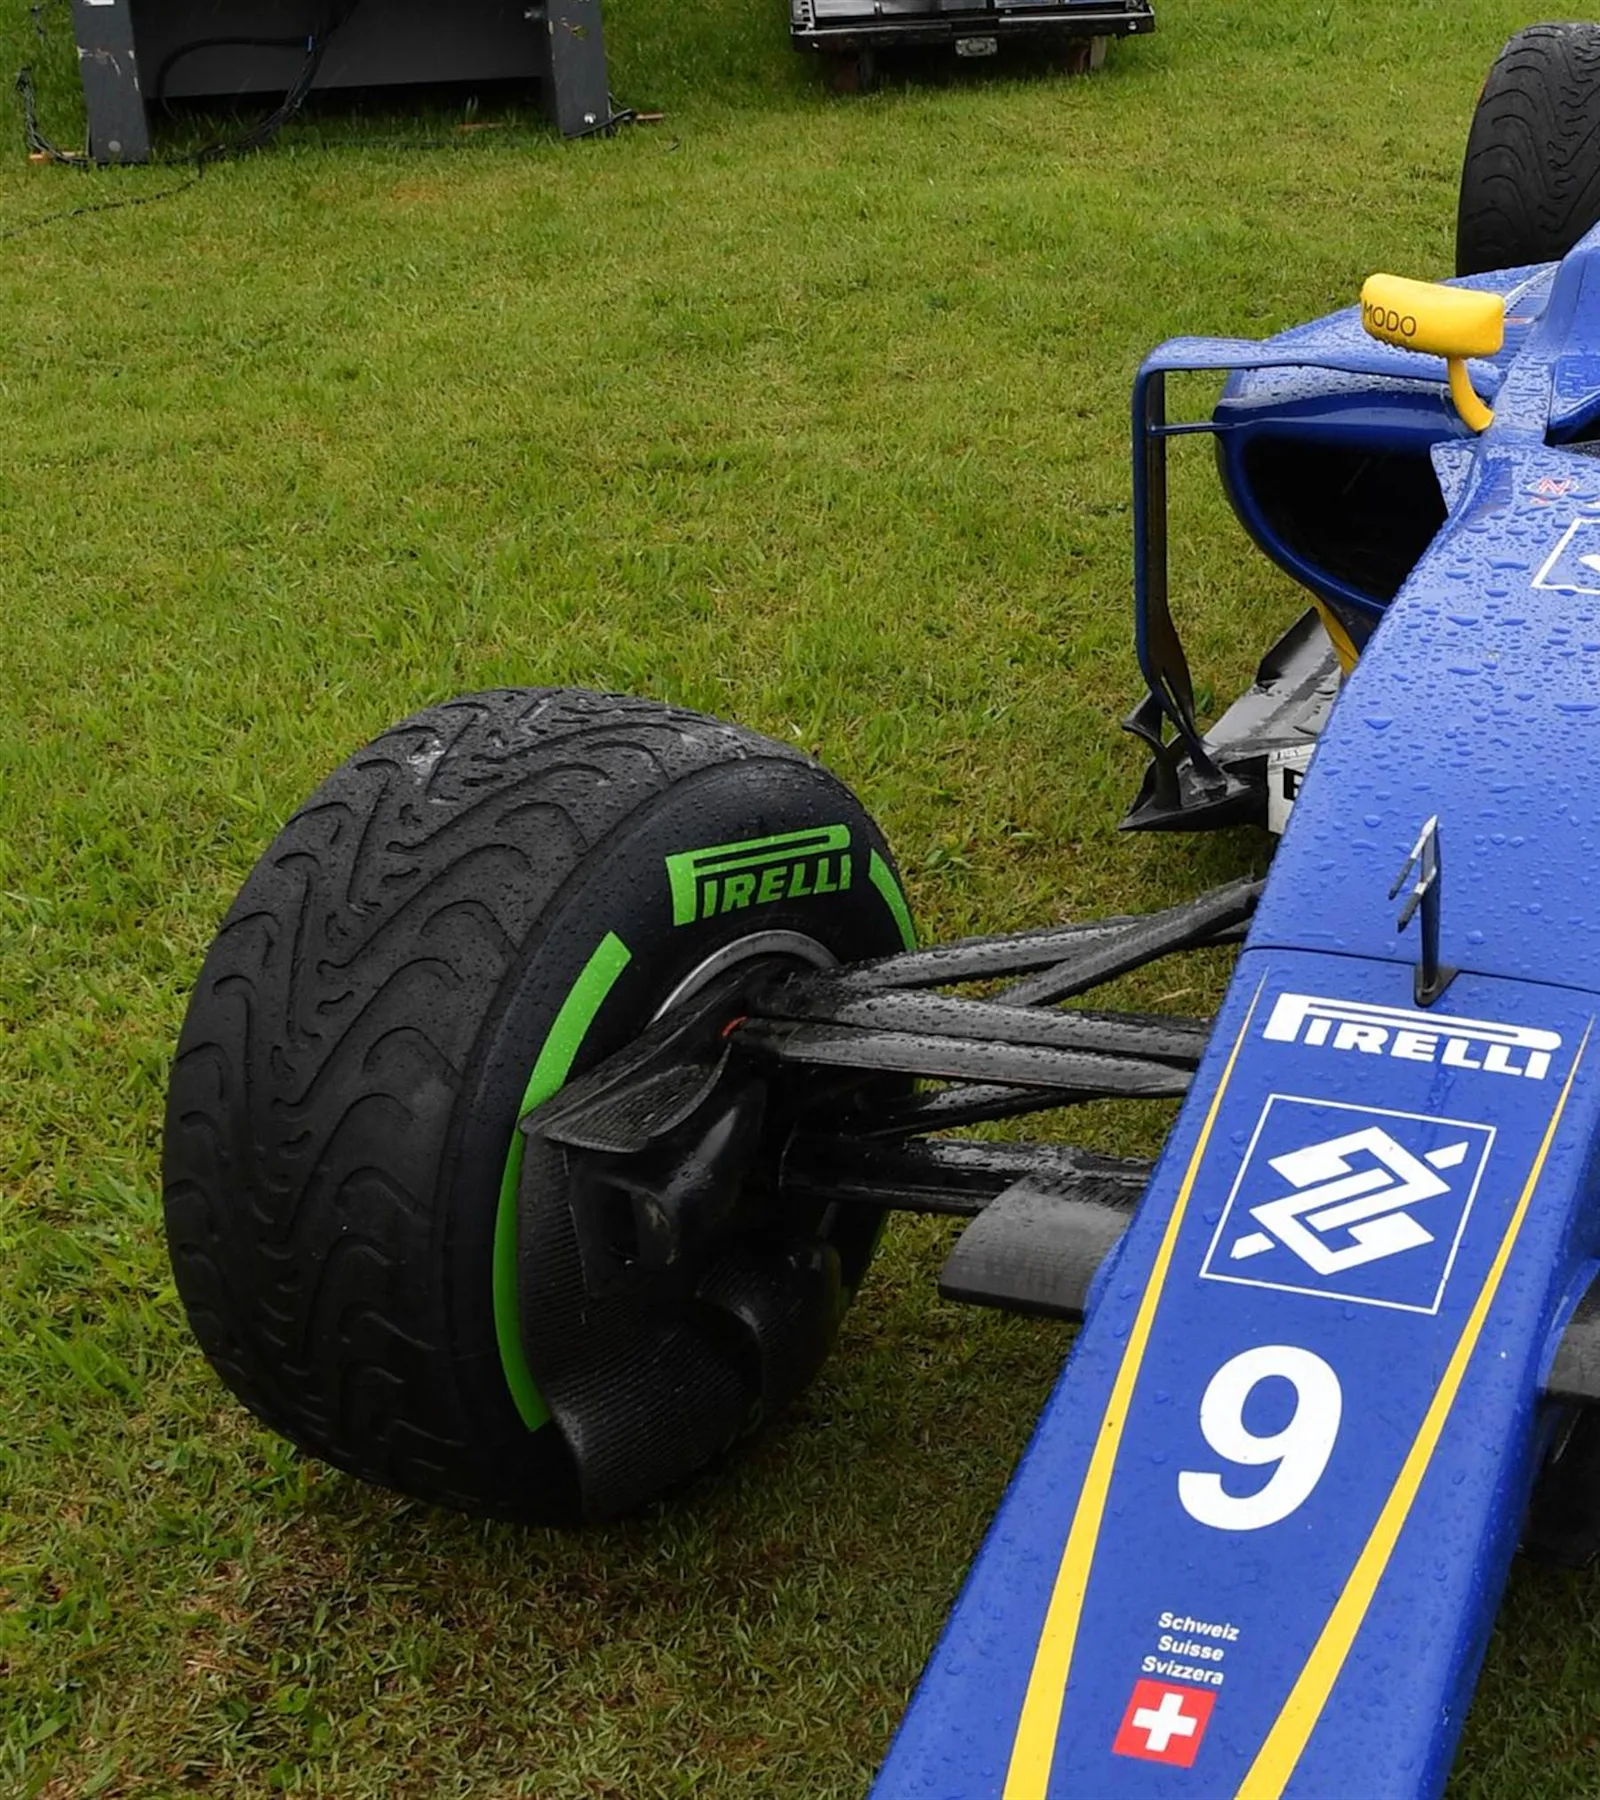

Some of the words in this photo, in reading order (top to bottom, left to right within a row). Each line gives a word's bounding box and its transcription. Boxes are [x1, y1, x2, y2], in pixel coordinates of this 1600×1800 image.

[1363, 299, 1417, 337] MODO
[664, 823, 852, 927] PIRELLI
[1262, 992, 1562, 1080] PIRELLI
[1177, 1344, 1343, 1531] 9
[1158, 1611, 1241, 1642] Schweiz
[1157, 1634, 1225, 1662] Suisse
[1141, 1655, 1225, 1686] Svizzera
